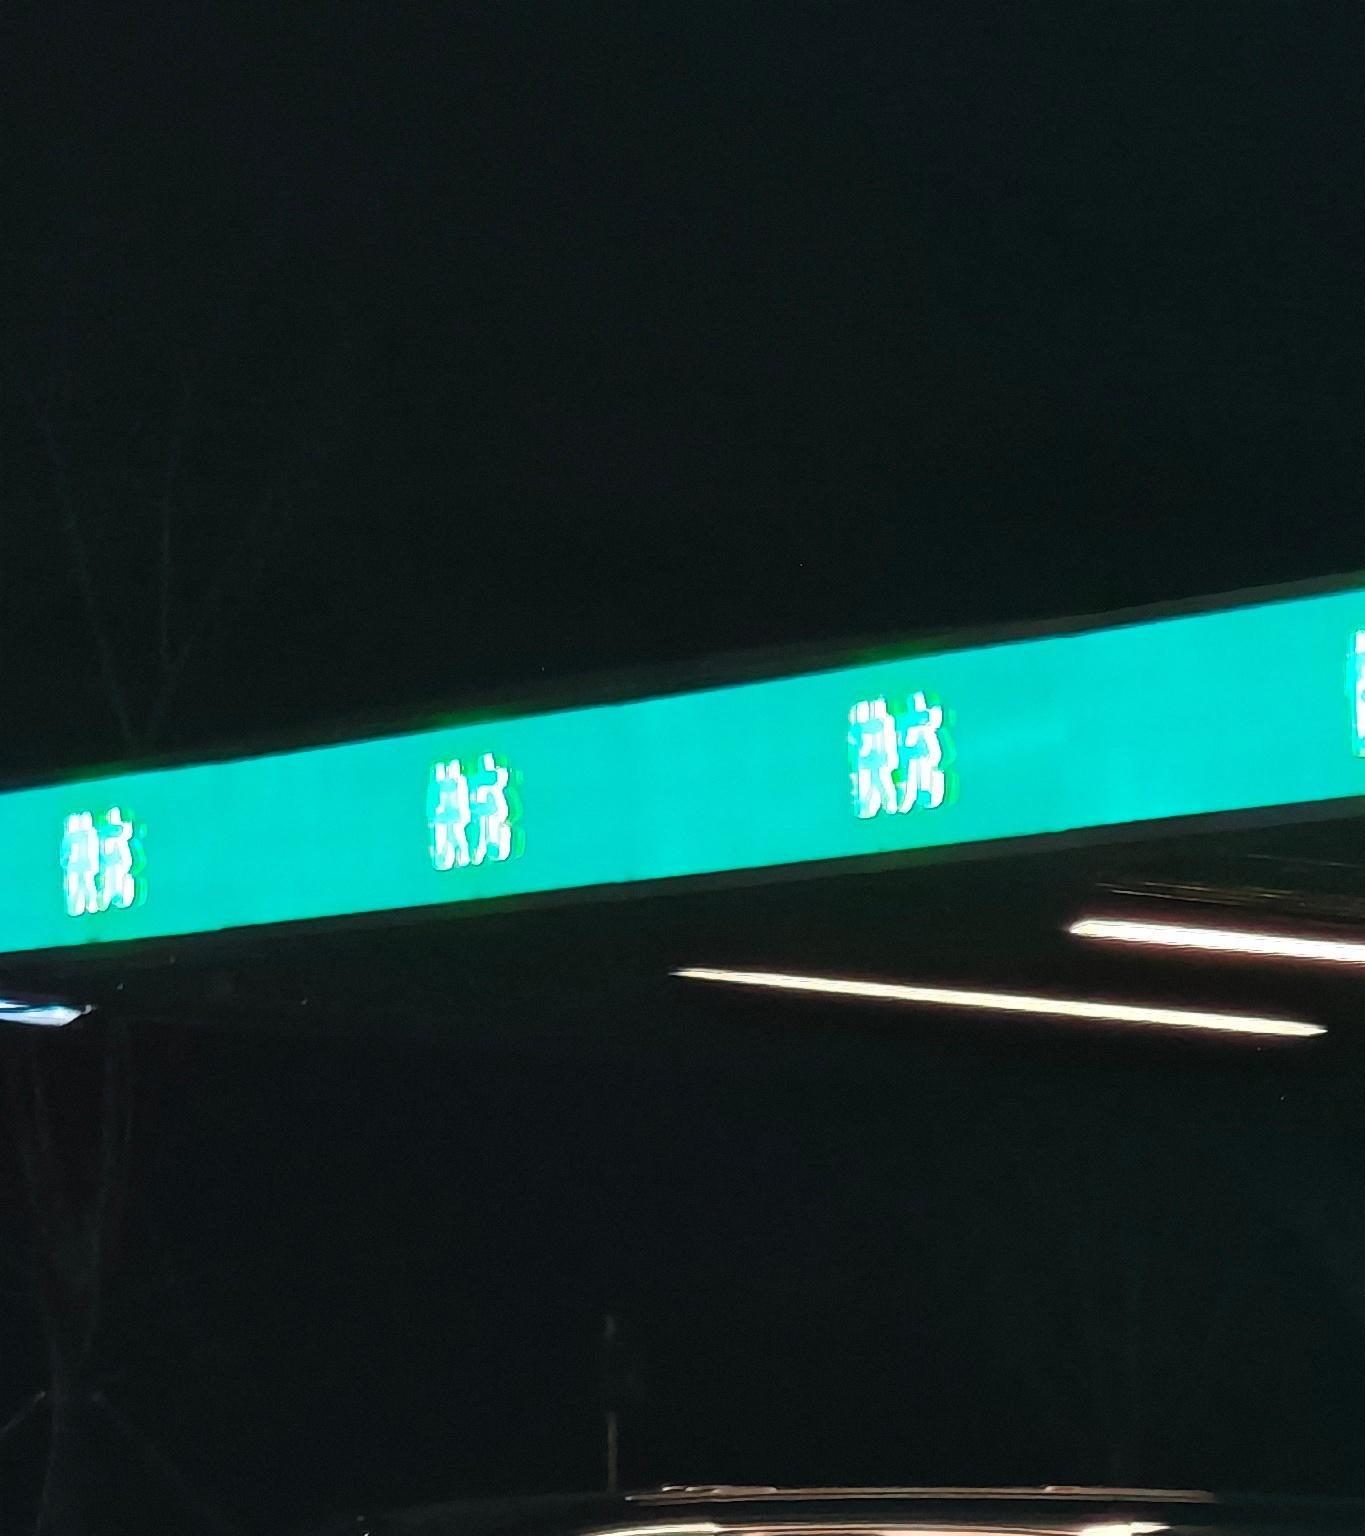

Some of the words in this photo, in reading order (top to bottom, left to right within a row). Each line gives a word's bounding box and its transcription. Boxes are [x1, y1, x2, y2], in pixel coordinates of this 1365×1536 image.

[427, 752, 512, 872] 快充
[848, 690, 945, 819] 快充
[60, 806, 135, 917] 快充
